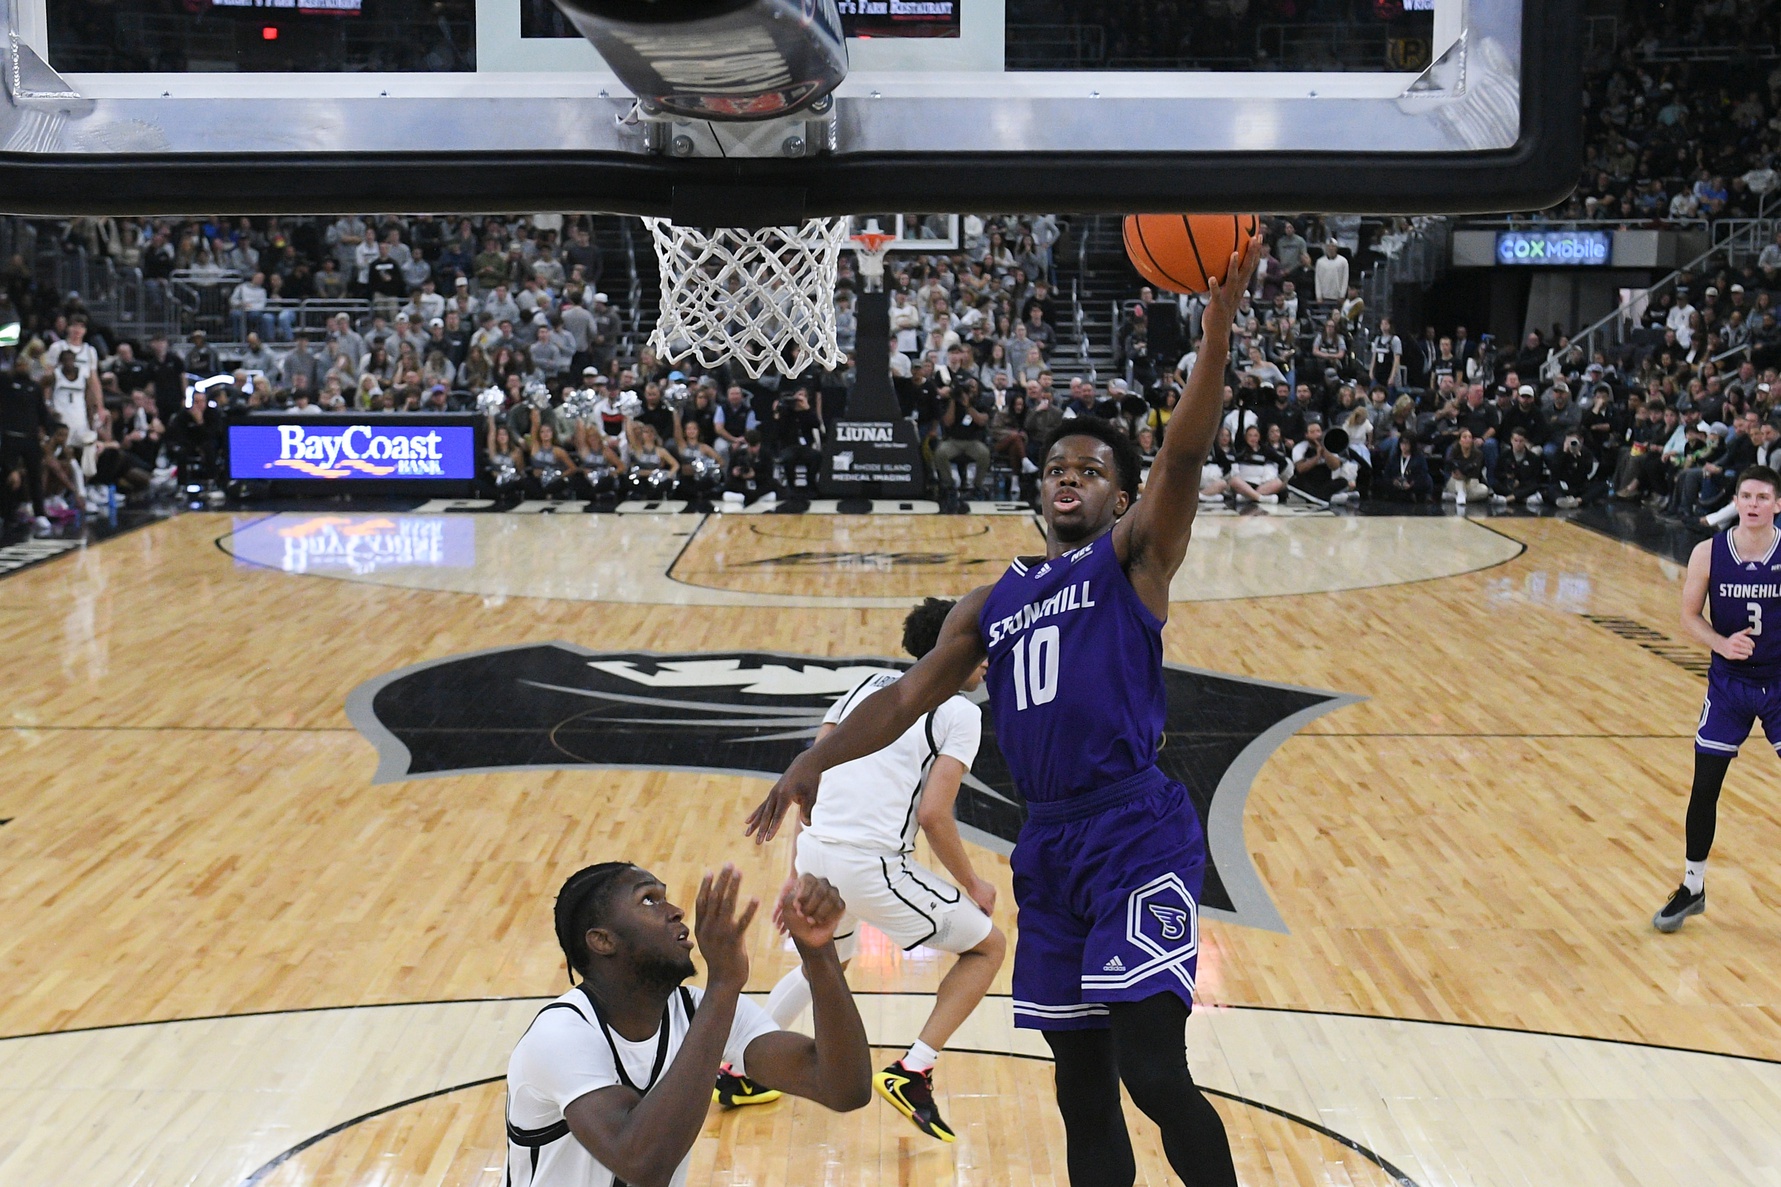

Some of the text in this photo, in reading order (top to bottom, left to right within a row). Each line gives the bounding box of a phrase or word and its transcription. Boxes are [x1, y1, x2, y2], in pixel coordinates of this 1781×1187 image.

[1500, 238, 1605, 258] COX Mobile
[277, 425, 443, 469] BayCoast
[1746, 601, 1762, 636] 3
[1011, 625, 1060, 711] 10
